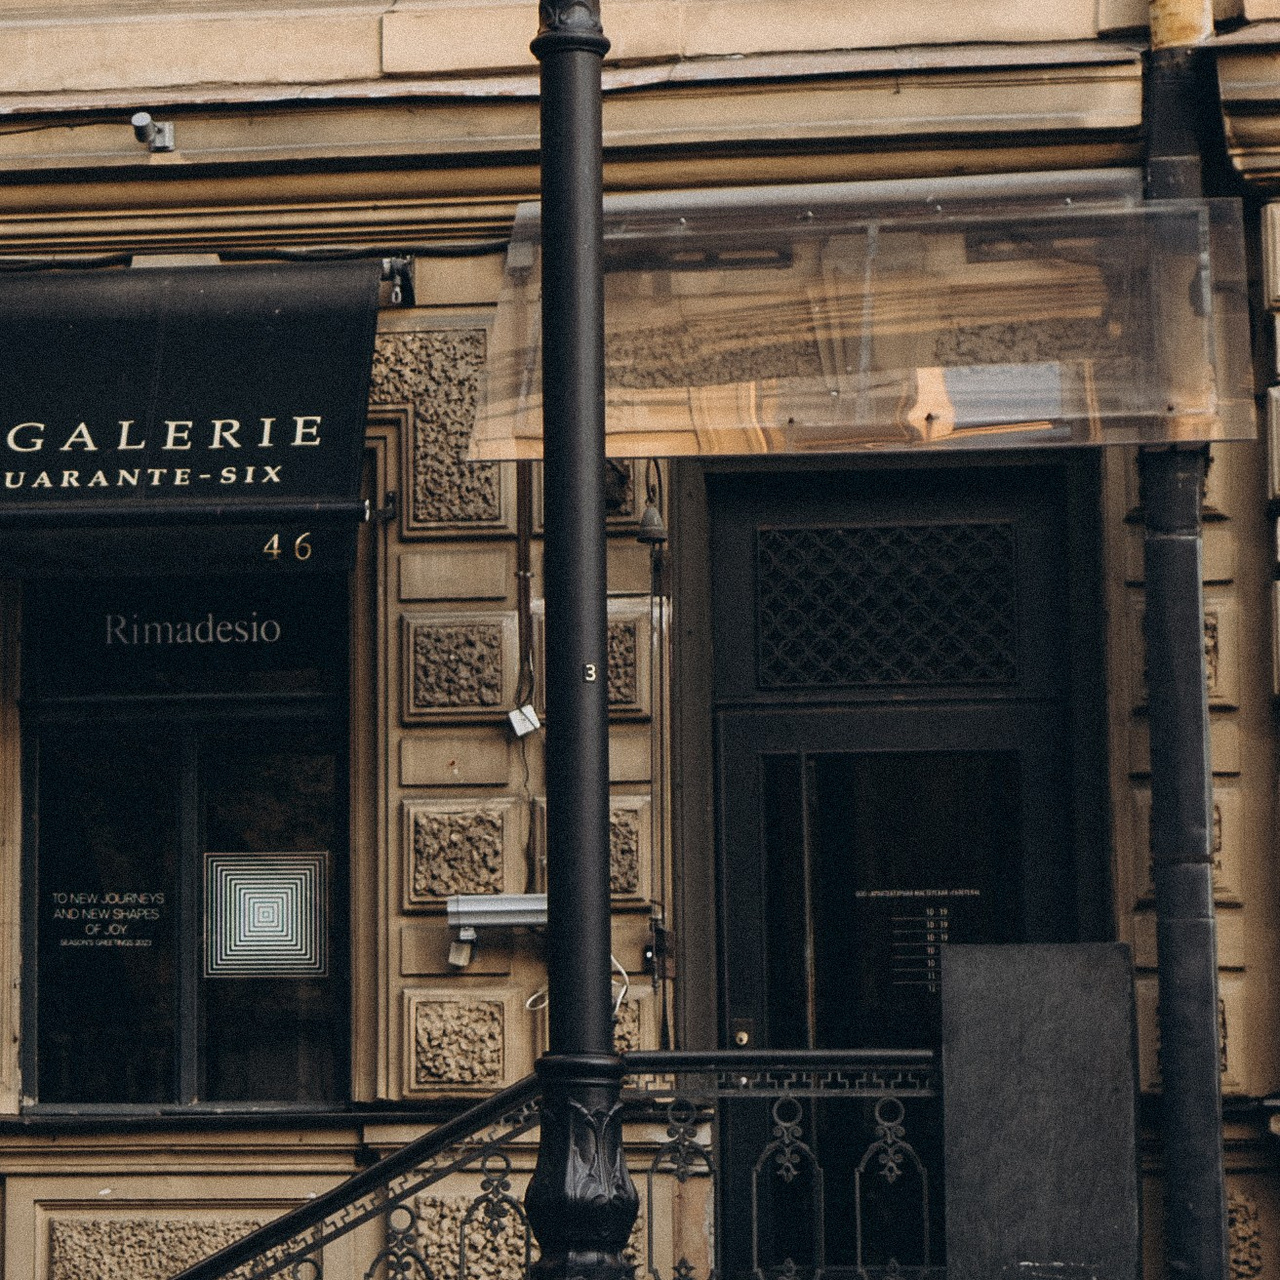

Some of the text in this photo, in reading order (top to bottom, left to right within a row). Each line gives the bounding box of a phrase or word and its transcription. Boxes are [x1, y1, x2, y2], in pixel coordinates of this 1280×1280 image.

[6, 416, 322, 453] GALERIE
[105, 611, 282, 645] Rimadesio
[585, 663, 596, 681] 3
[52, 892, 165, 904] TO NEW JOURNEYS
[53, 908, 160, 920] AND NEW SHAPES
[84, 923, 128, 935] OF JOY
